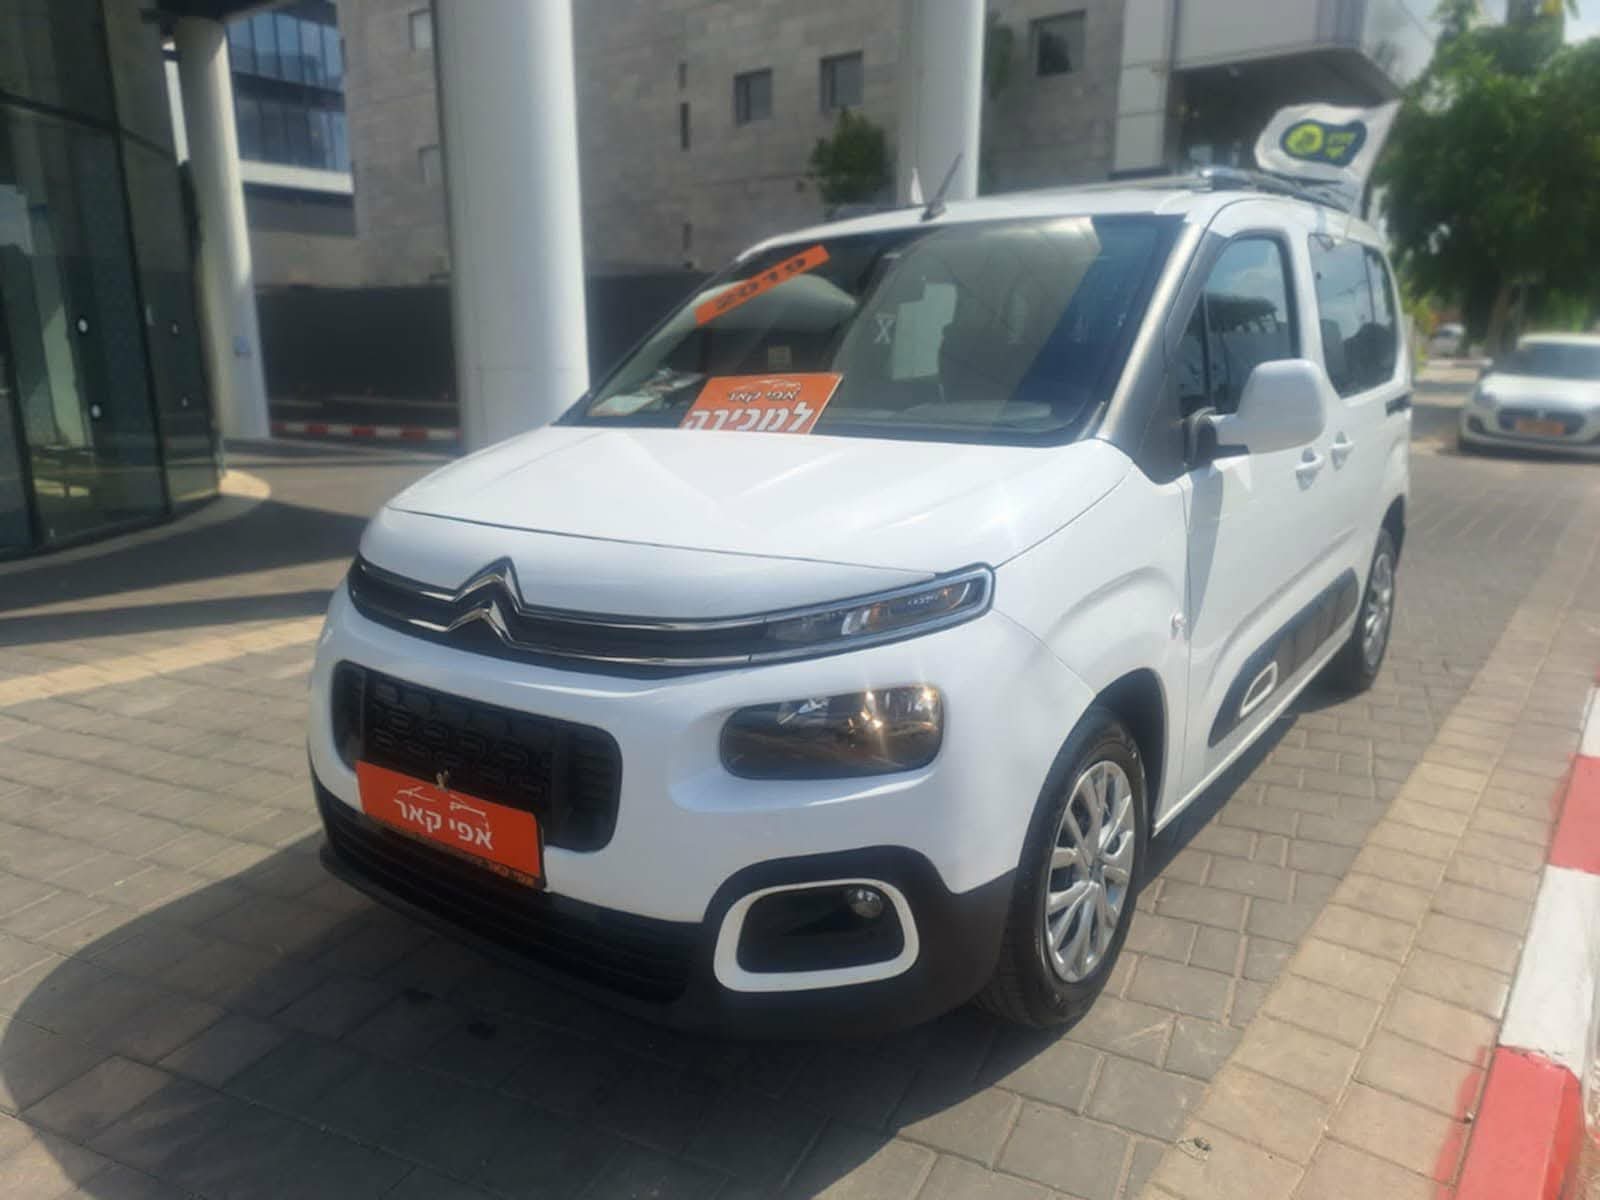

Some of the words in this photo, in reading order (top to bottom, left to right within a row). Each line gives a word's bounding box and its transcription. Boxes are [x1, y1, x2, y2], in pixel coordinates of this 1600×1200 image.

[715, 257, 806, 310] 2019
[684, 400, 815, 432] למכירה
[393, 798, 443, 833] קאר
[449, 817, 494, 850] אפי
